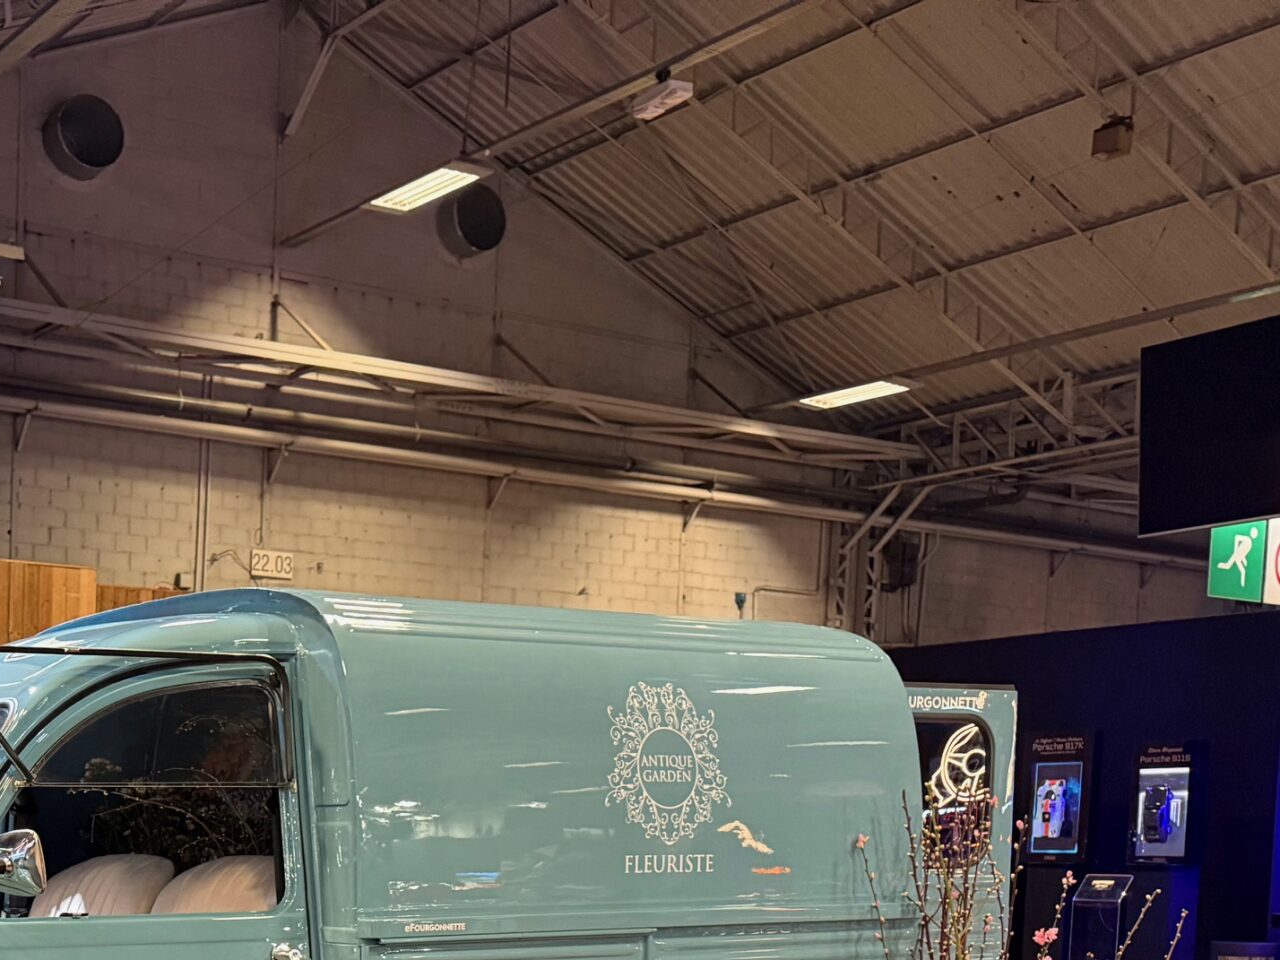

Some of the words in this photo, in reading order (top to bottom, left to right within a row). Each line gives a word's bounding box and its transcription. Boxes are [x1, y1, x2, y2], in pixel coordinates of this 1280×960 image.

[252, 553, 293, 575] 22.03
[1032, 742, 1064, 751] Porsche
[641, 754, 694, 770] ANTIQUE
[1140, 755, 1171, 764] Porsche
[642, 770, 692, 783] GARDEN
[624, 853, 715, 874] FLEURISTE
[404, 922, 466, 933] eFOURGONNETTE
